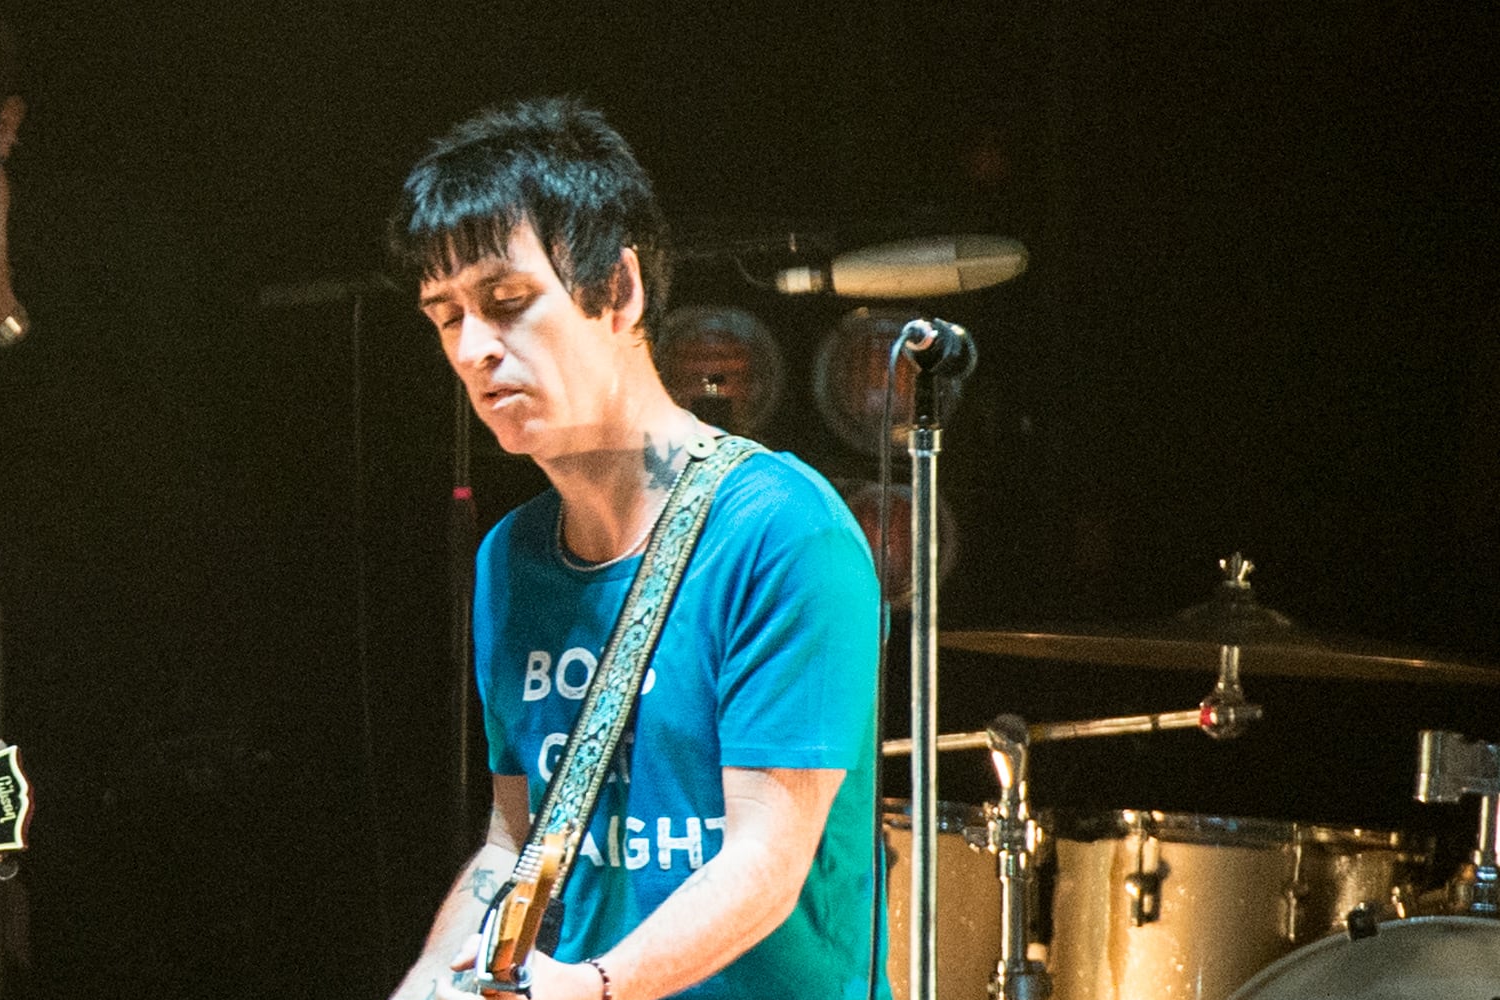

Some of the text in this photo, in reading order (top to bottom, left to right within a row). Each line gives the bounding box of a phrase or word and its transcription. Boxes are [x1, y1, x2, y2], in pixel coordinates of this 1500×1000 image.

[522, 646, 657, 701] BO
[538, 731, 635, 784] GT
[529, 812, 726, 871] AIGH
